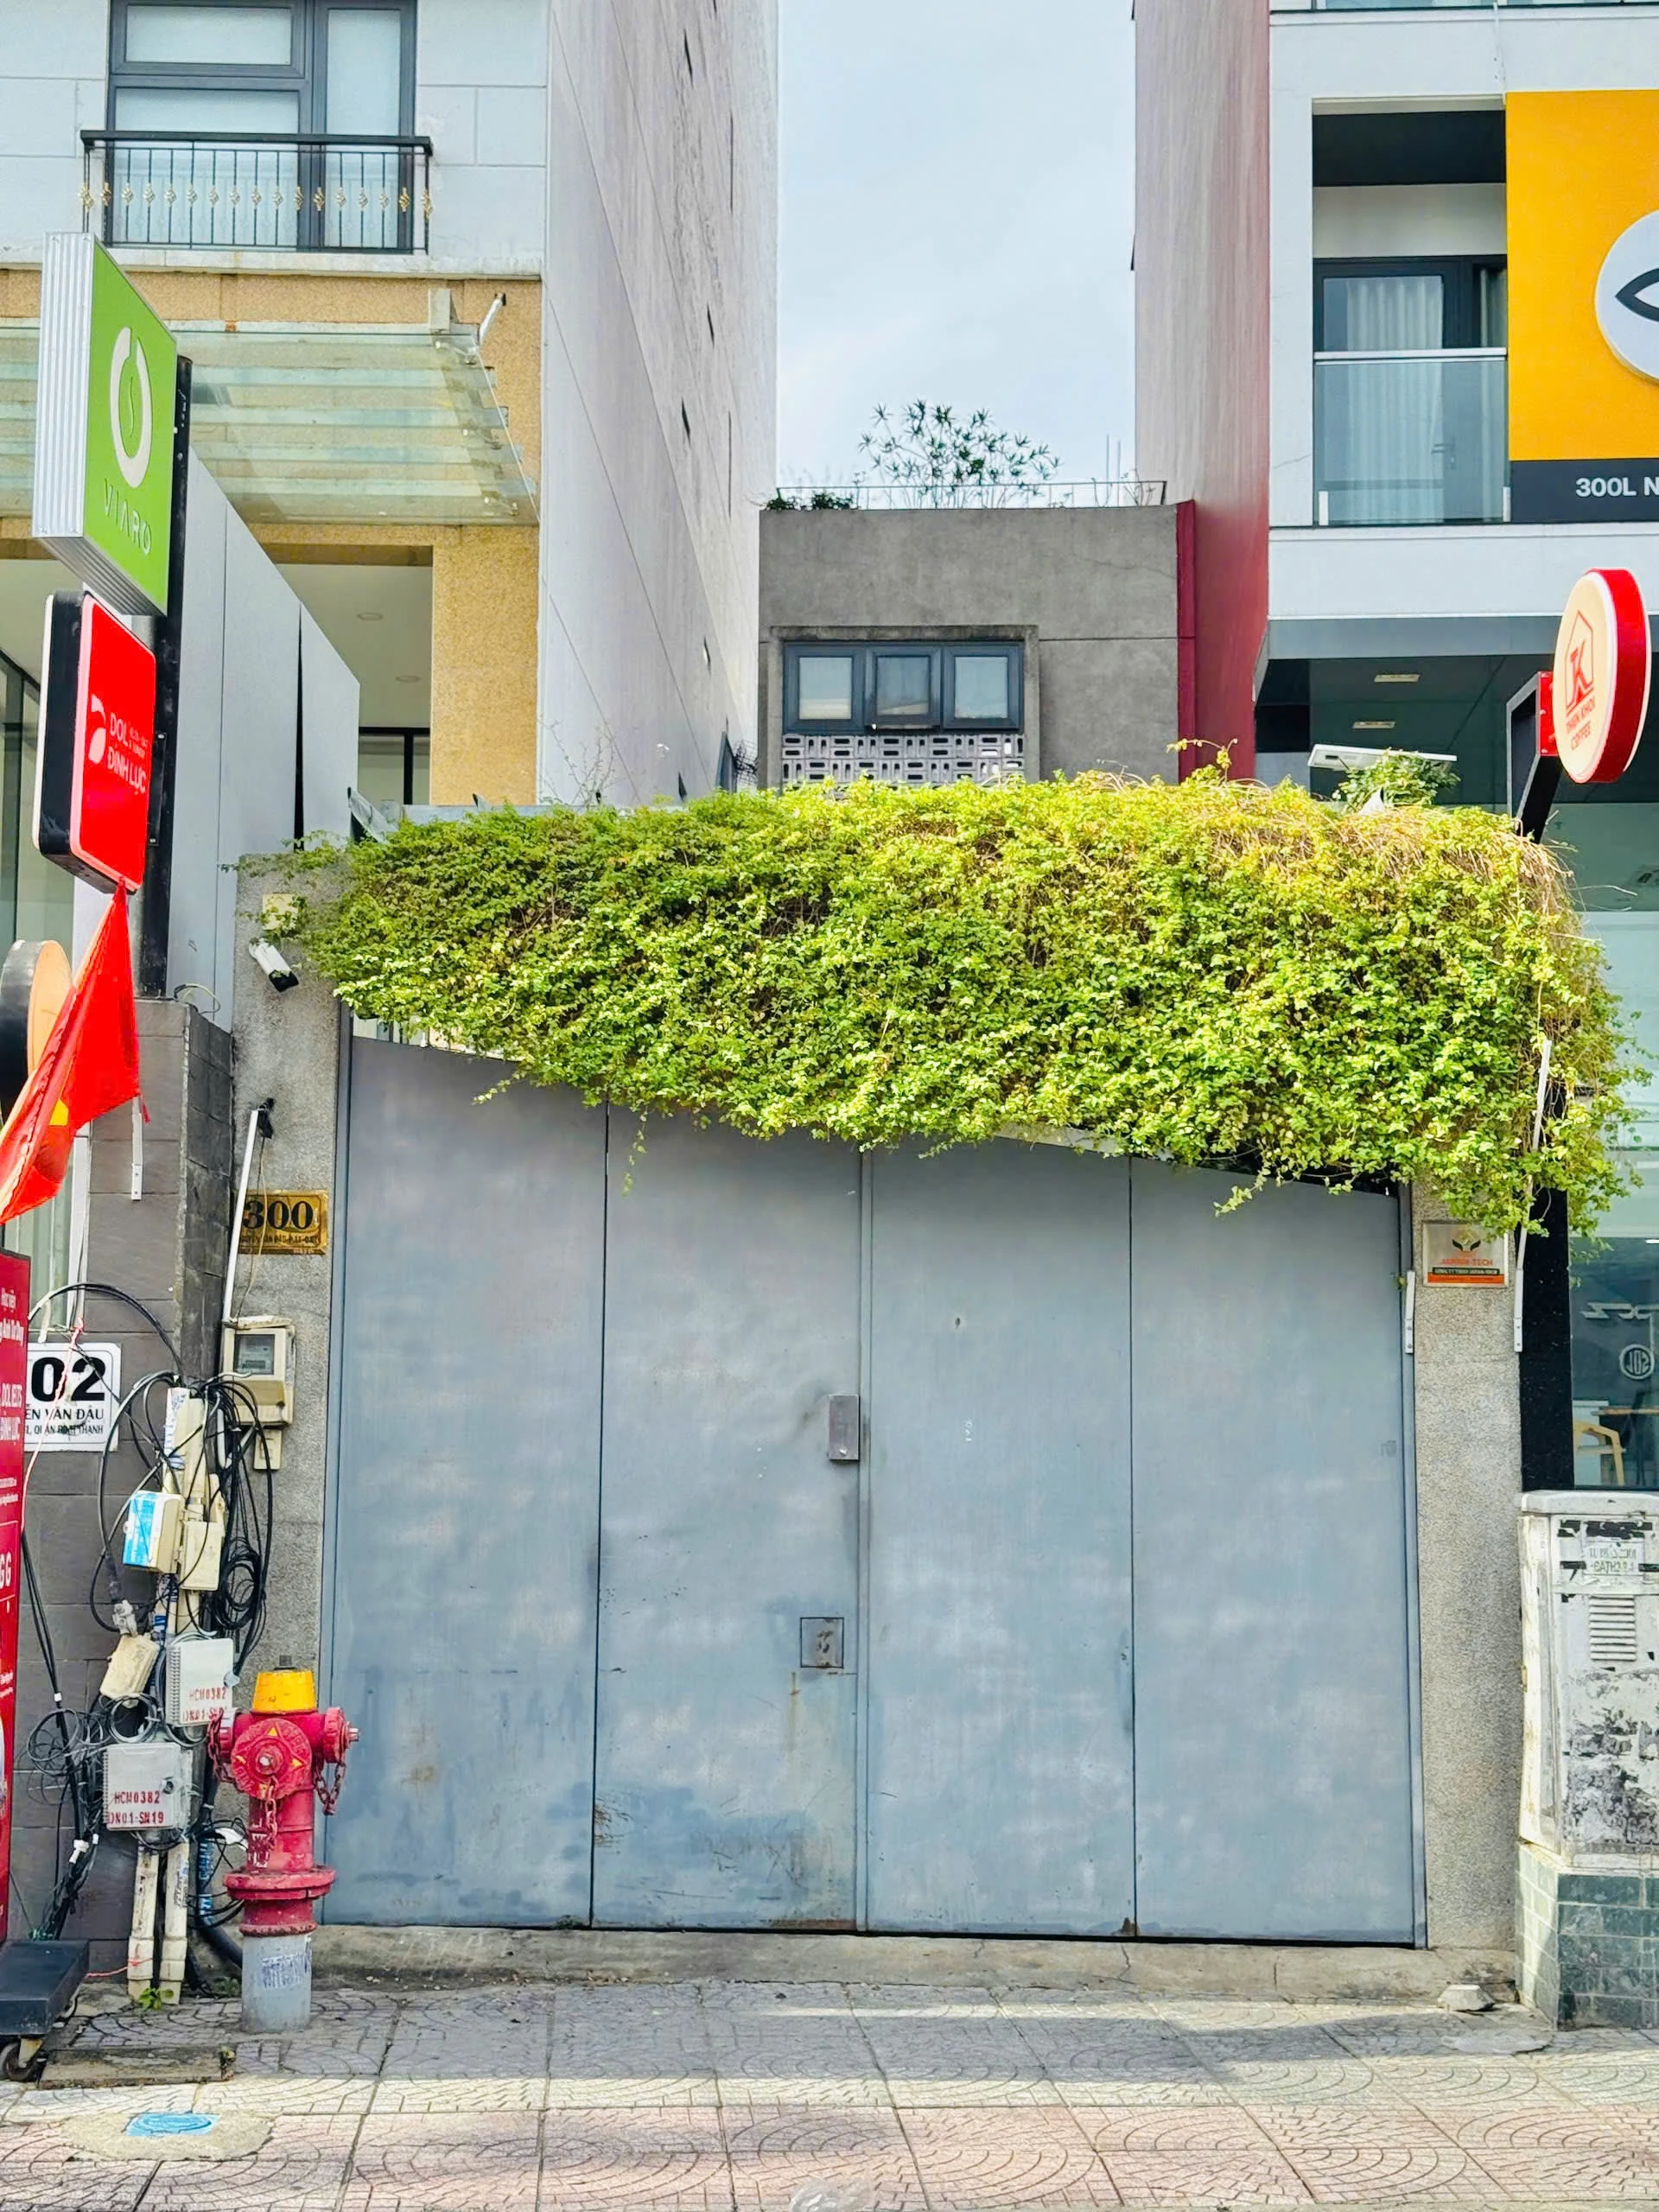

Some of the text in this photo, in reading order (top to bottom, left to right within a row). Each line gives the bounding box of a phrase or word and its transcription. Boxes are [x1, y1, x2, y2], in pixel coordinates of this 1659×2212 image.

[1575, 477, 1637, 497] 300L
[110, 711, 129, 747] DOL
[243, 1200, 314, 1230] 300
[31, 1357, 105, 1402] 02
[114, 1790, 160, 1804] HCM0382
